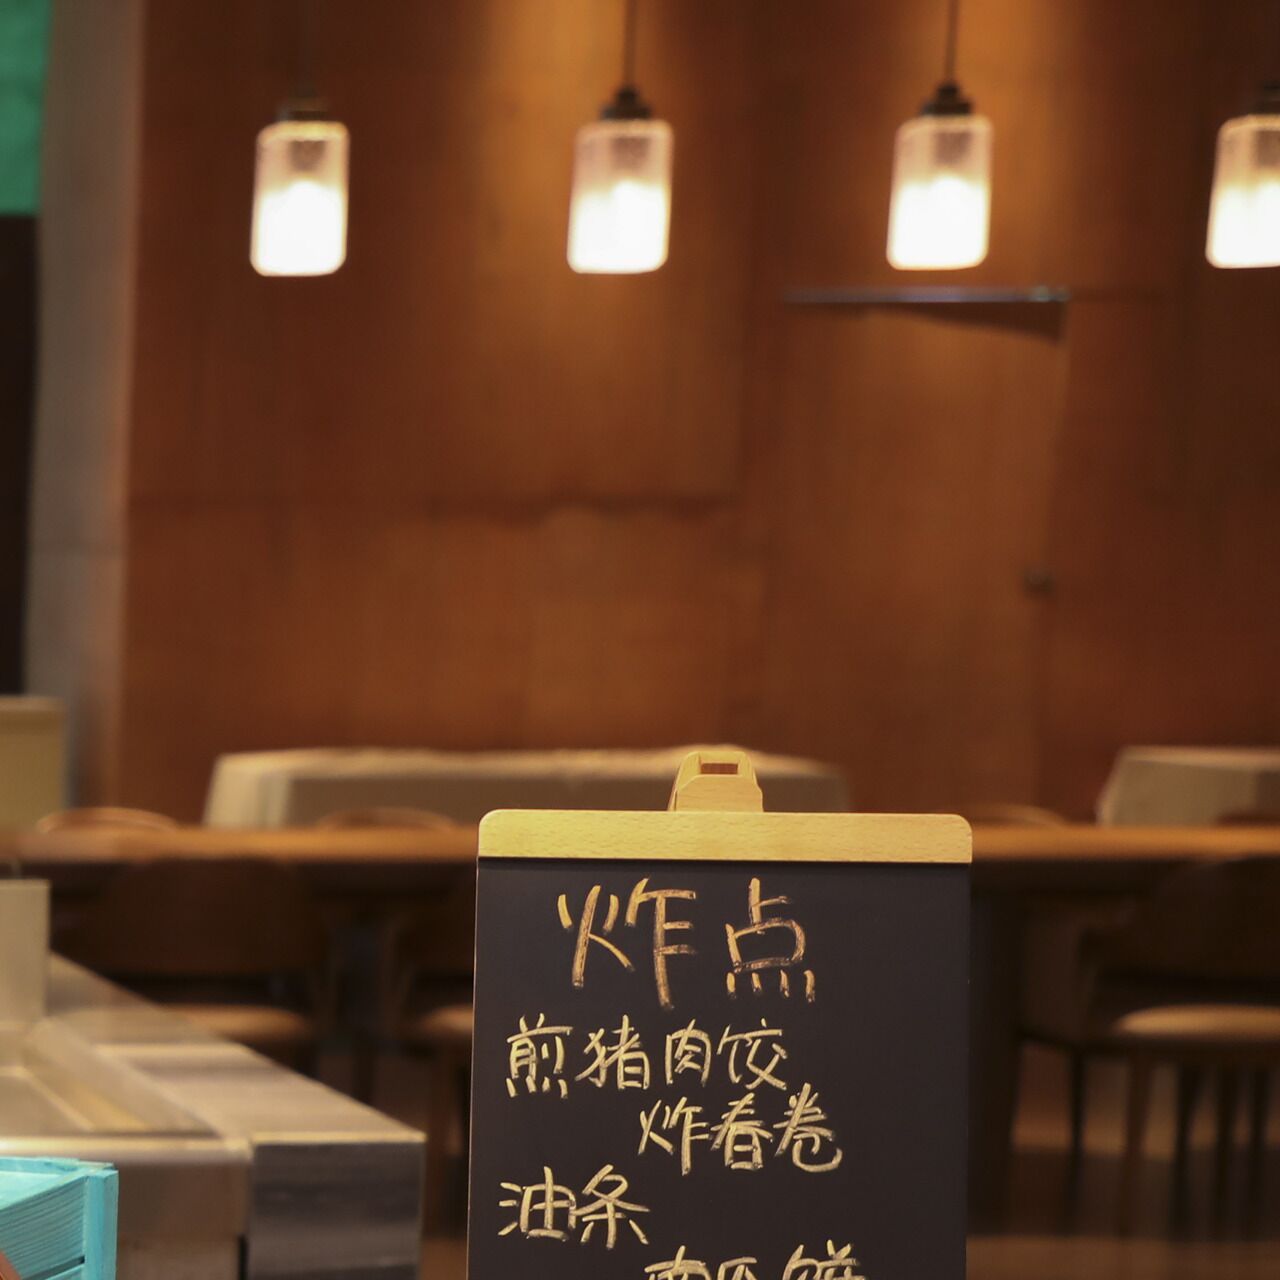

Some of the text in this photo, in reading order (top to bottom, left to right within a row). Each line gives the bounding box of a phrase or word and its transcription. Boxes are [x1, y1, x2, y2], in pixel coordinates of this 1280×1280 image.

[557, 877, 818, 1010] 炸点
[505, 1013, 790, 1098] 煎猪肉饺
[638, 1083, 844, 1176] 炸春卷
[497, 1164, 651, 1250] 油条
